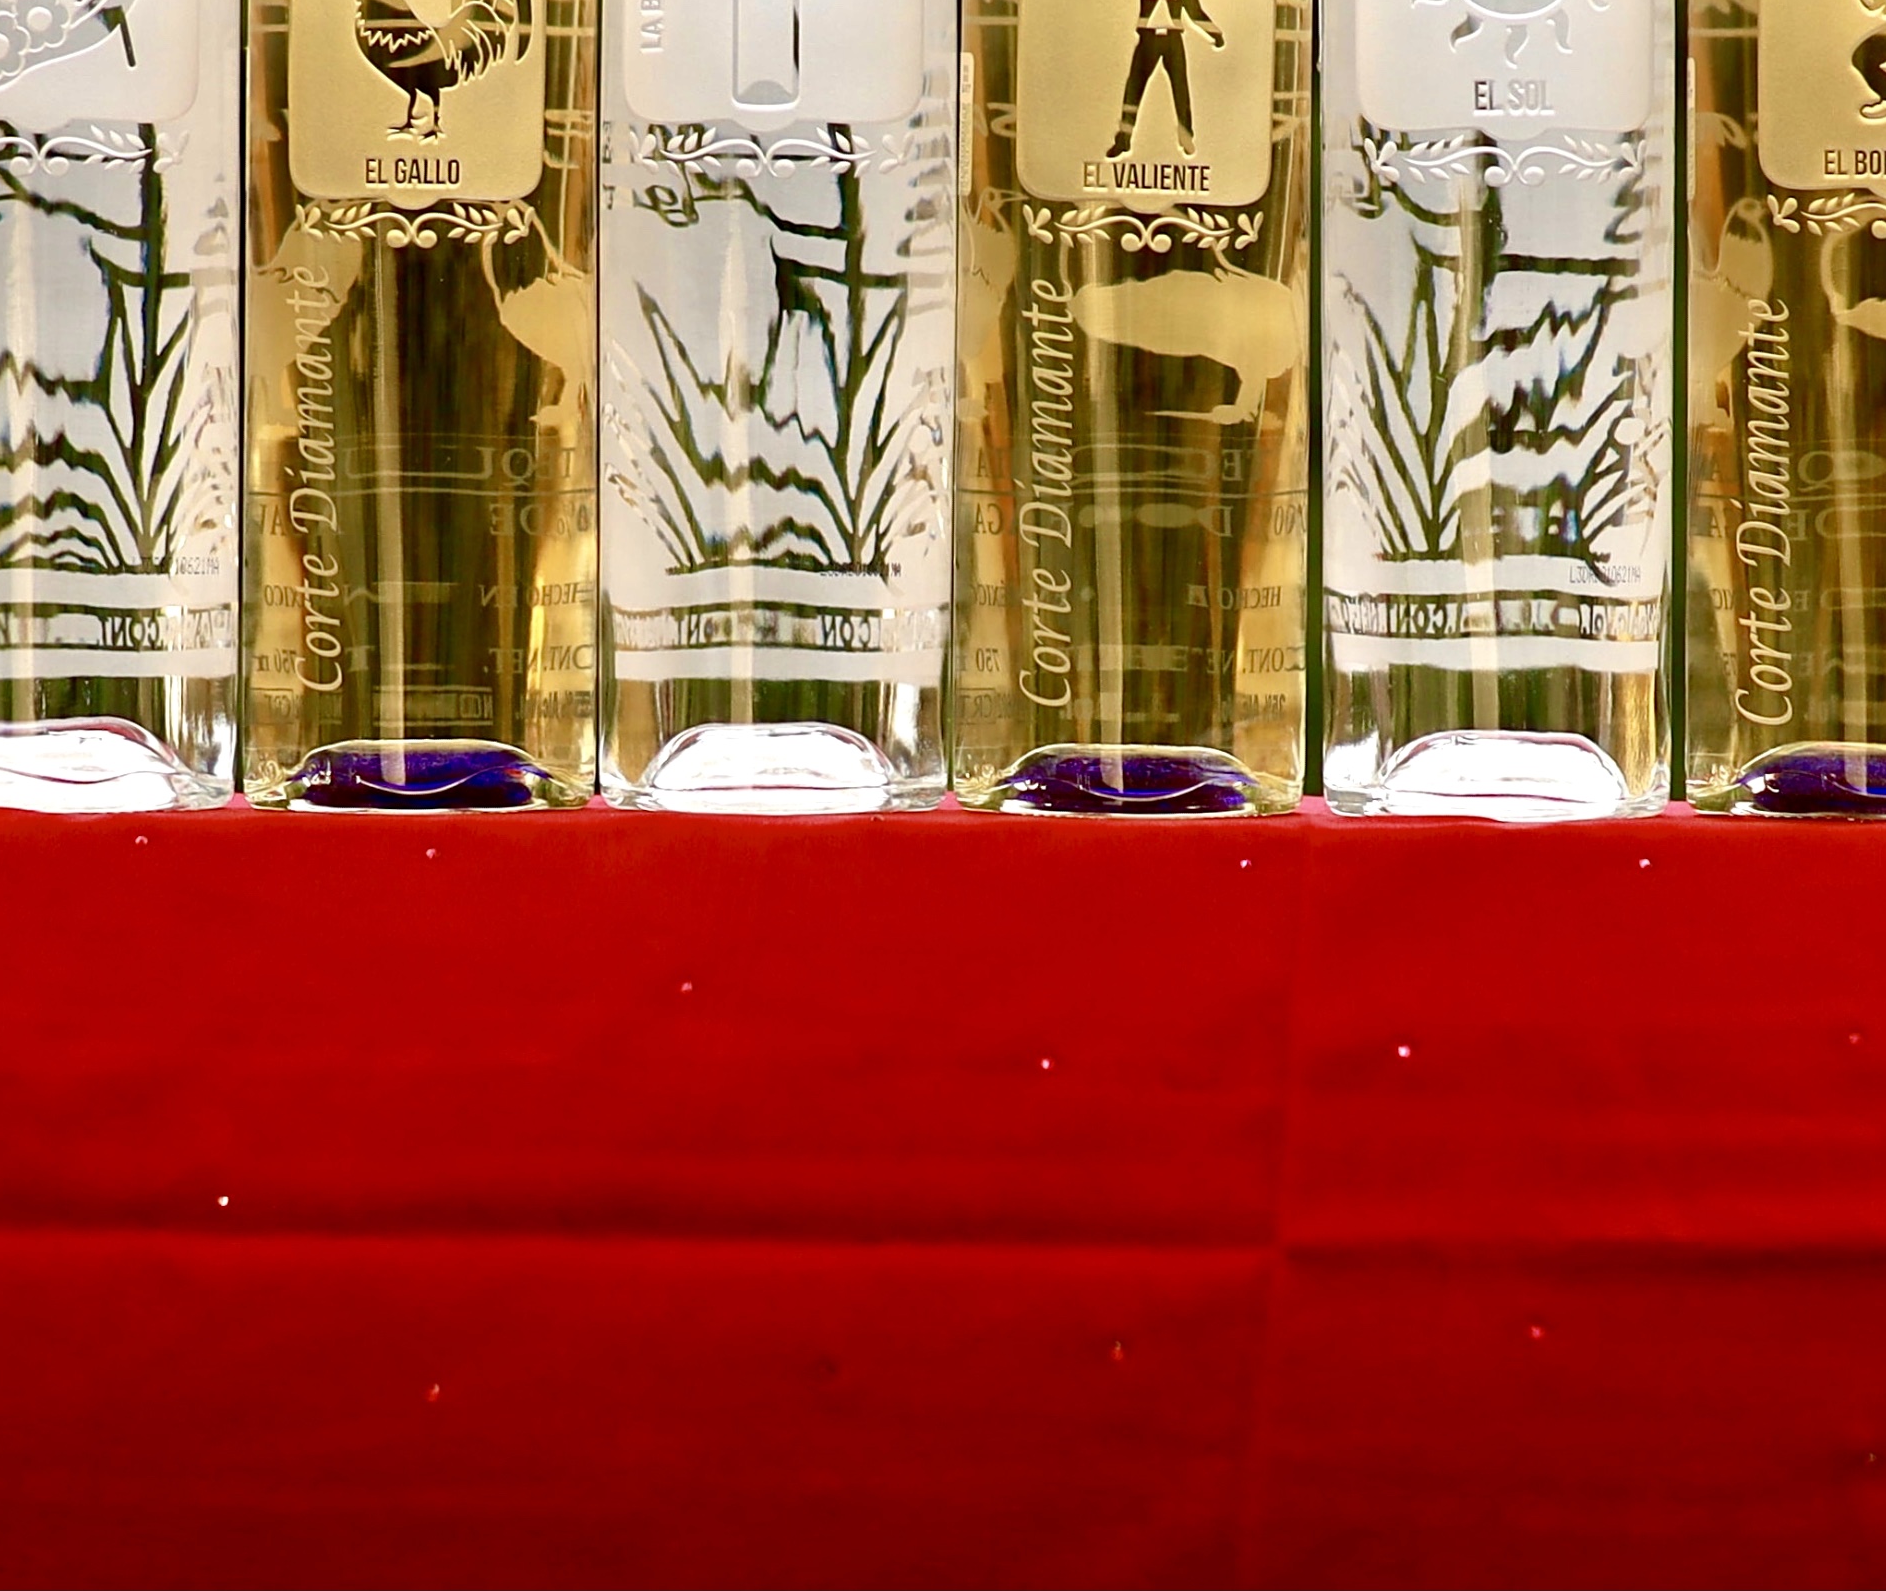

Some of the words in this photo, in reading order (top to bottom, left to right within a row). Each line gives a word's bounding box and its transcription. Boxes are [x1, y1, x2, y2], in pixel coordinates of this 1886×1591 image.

[640, 17, 664, 53] LA
[1473, 79, 1504, 116] EL
[1507, 78, 1556, 116] SOL
[364, 158, 390, 190] EL
[393, 158, 462, 190] GALLO
[1082, 161, 1110, 194] EL
[1112, 162, 1212, 196] VALIENTE
[1823, 148, 1849, 180] EL
[293, 552, 345, 692] Corte
[1018, 567, 1073, 708] Corte
[1734, 586, 1794, 726] Corte
